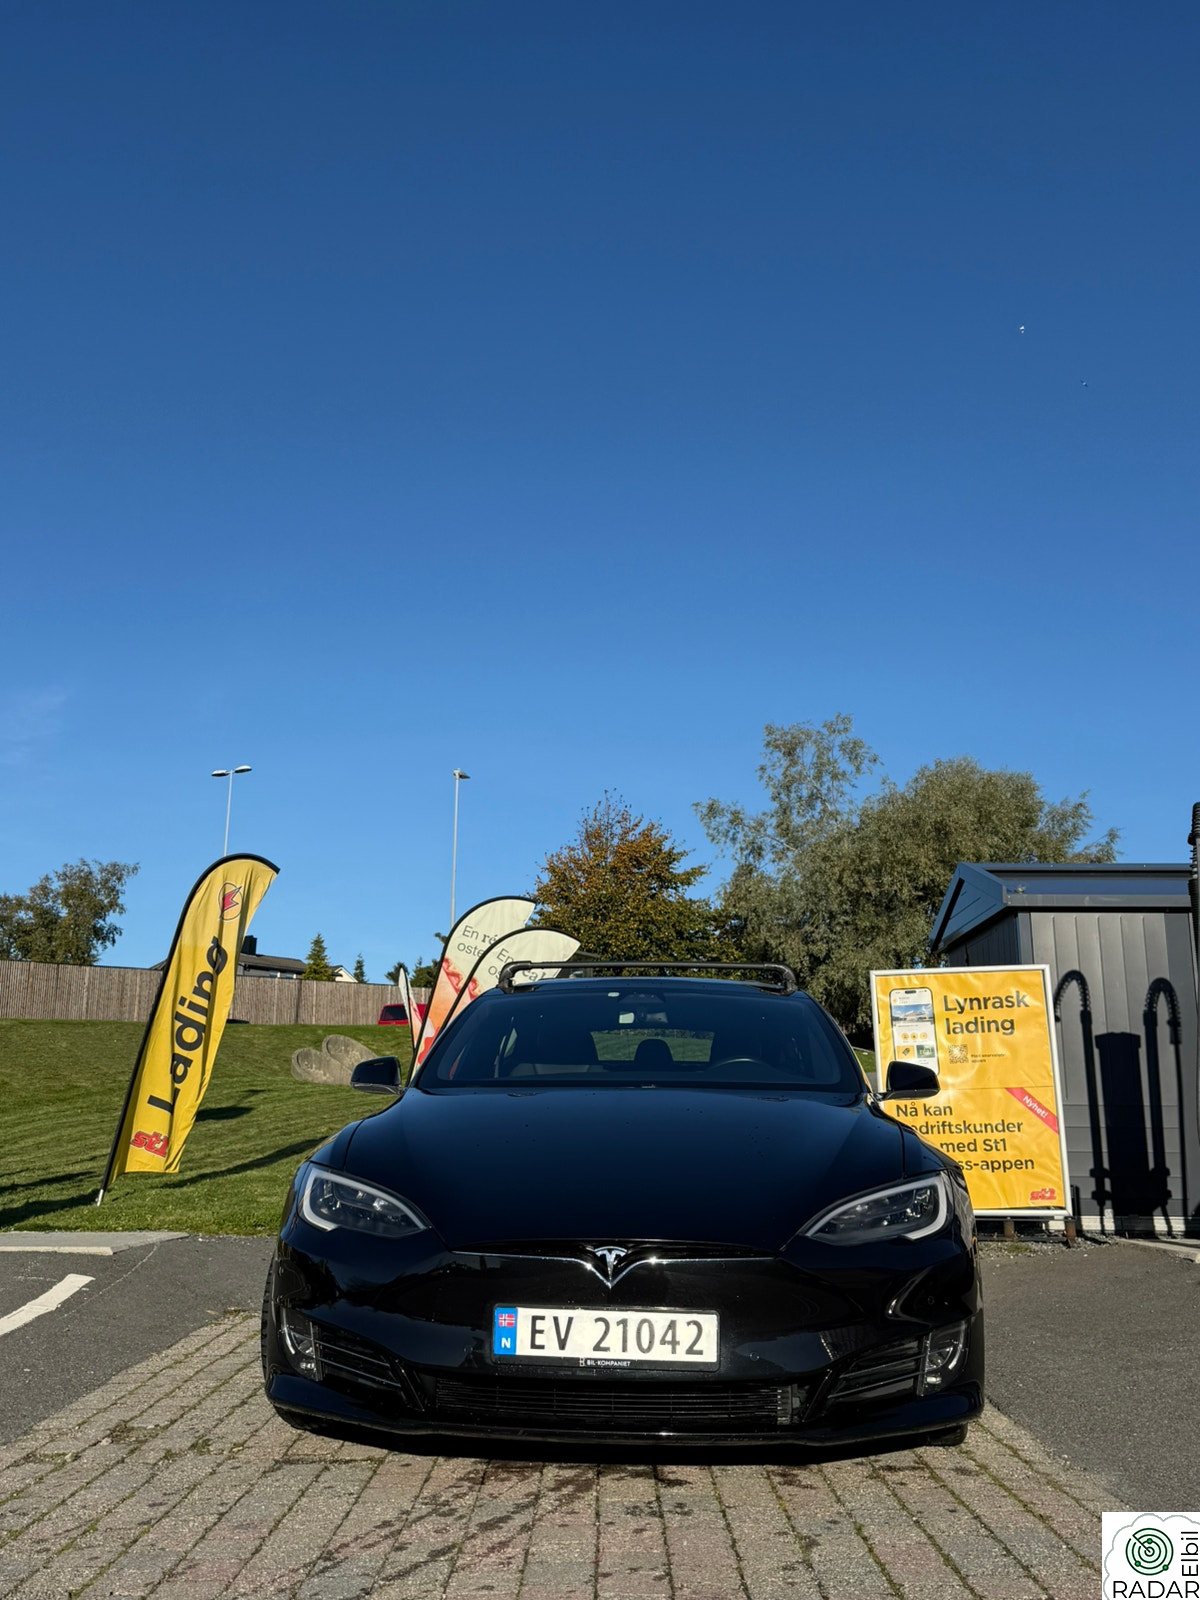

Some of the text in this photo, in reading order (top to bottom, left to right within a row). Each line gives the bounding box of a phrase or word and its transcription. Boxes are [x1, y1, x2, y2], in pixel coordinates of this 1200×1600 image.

[462, 925, 479, 940] En
[457, 942, 485, 957] oste
[943, 990, 1030, 1015] Lynrask
[945, 1017, 1016, 1036] lading
[896, 1101, 953, 1118] Nå kan
[1022, 1095, 1049, 1119] Nyhet!
[940, 1138, 1007, 1153] med St1
[958, 1158, 1035, 1174] ss-appen
[501, 1337, 511, 1349] N
[530, 1315, 704, 1356] EV 21042
